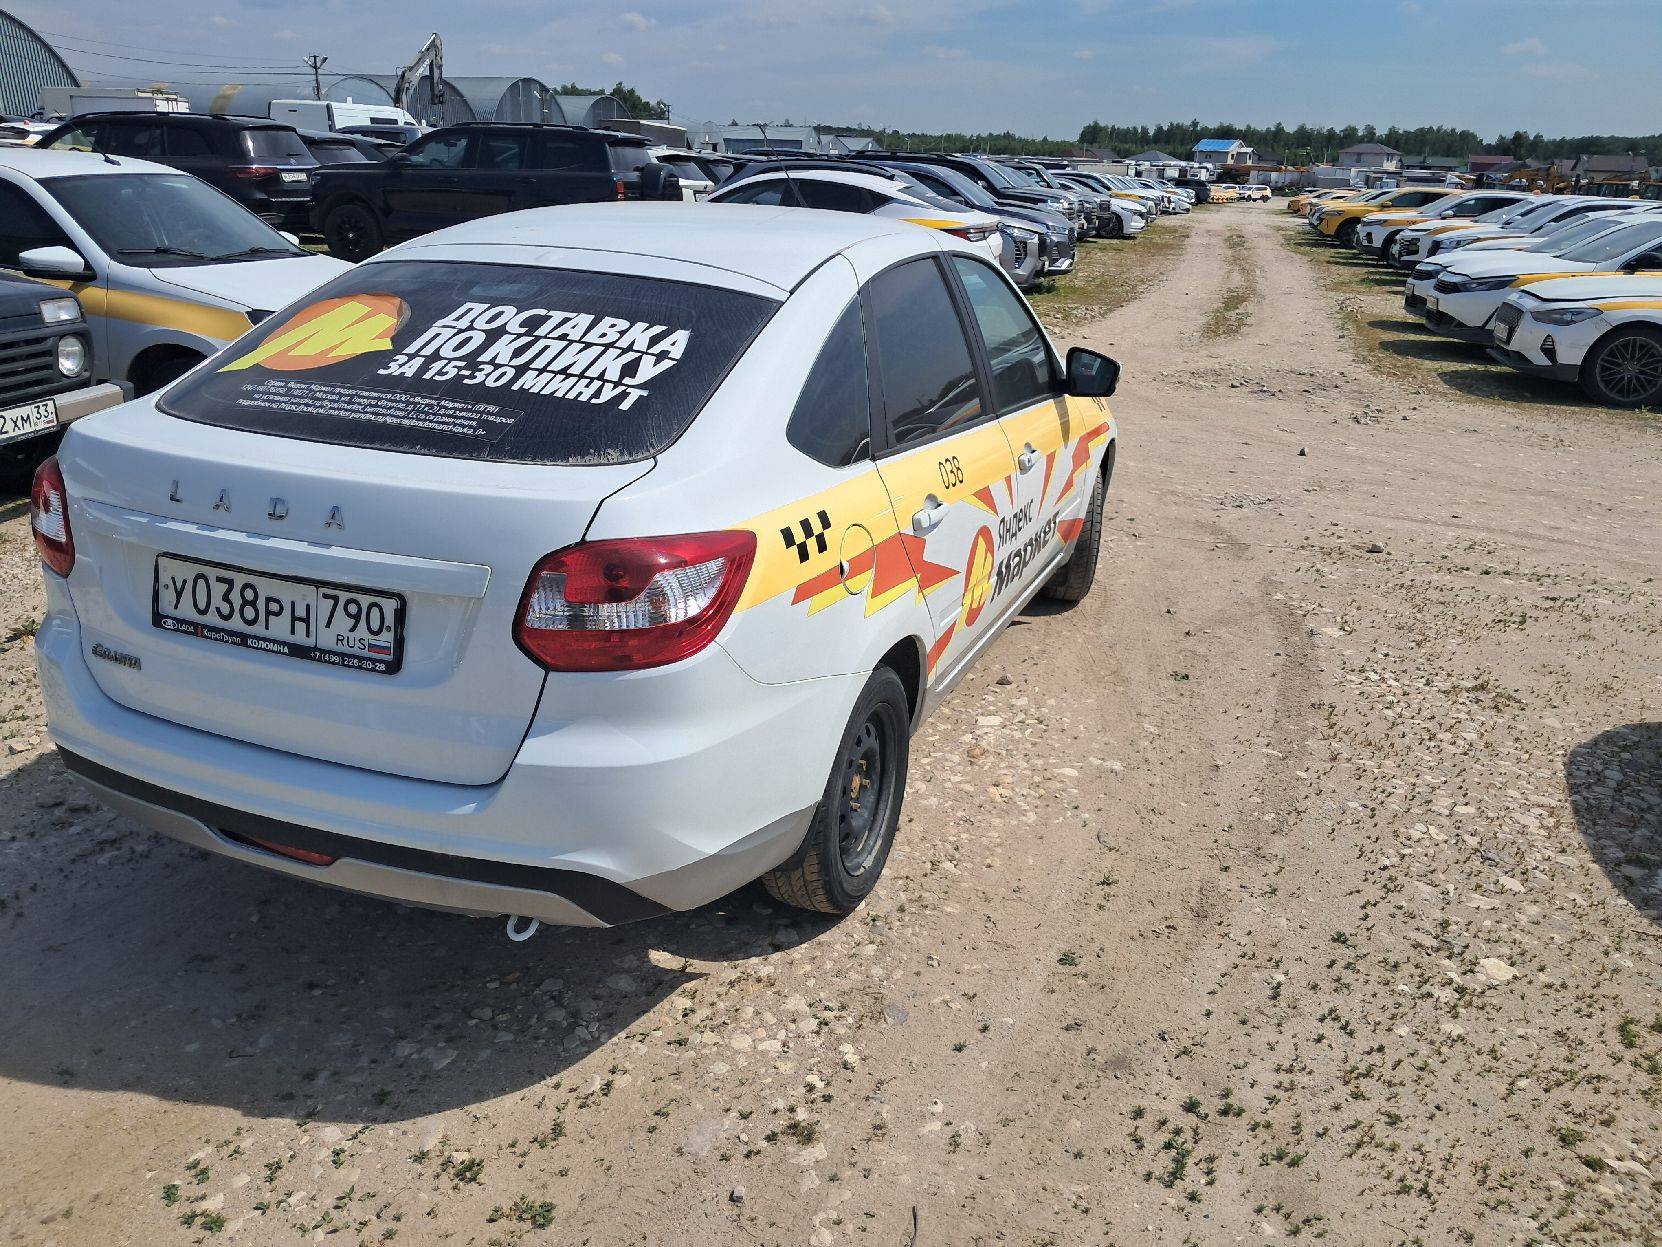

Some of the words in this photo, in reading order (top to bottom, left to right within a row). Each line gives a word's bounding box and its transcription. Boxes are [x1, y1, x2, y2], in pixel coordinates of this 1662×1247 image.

[402, 326, 486, 359] ПО
[477, 334, 678, 386] КЛИКУ
[432, 301, 693, 360] ДОСТАВКА
[377, 355, 426, 379] ЗА
[422, 361, 516, 389] 15-30
[511, 373, 650, 411] МИНУТ
[34, 403, 50, 420] 33
[938, 455, 965, 490] 038
[169, 479, 346, 530] LADA
[997, 498, 1034, 551] Яндекс
[989, 510, 1061, 605] Маркет
[170, 572, 312, 638] У038РН
[321, 592, 386, 637] 790
[178, 623, 195, 633] LADA
[247, 638, 289, 654] КОЛОМНА
[310, 651, 321, 660] +7
[335, 633, 367, 651] RUS
